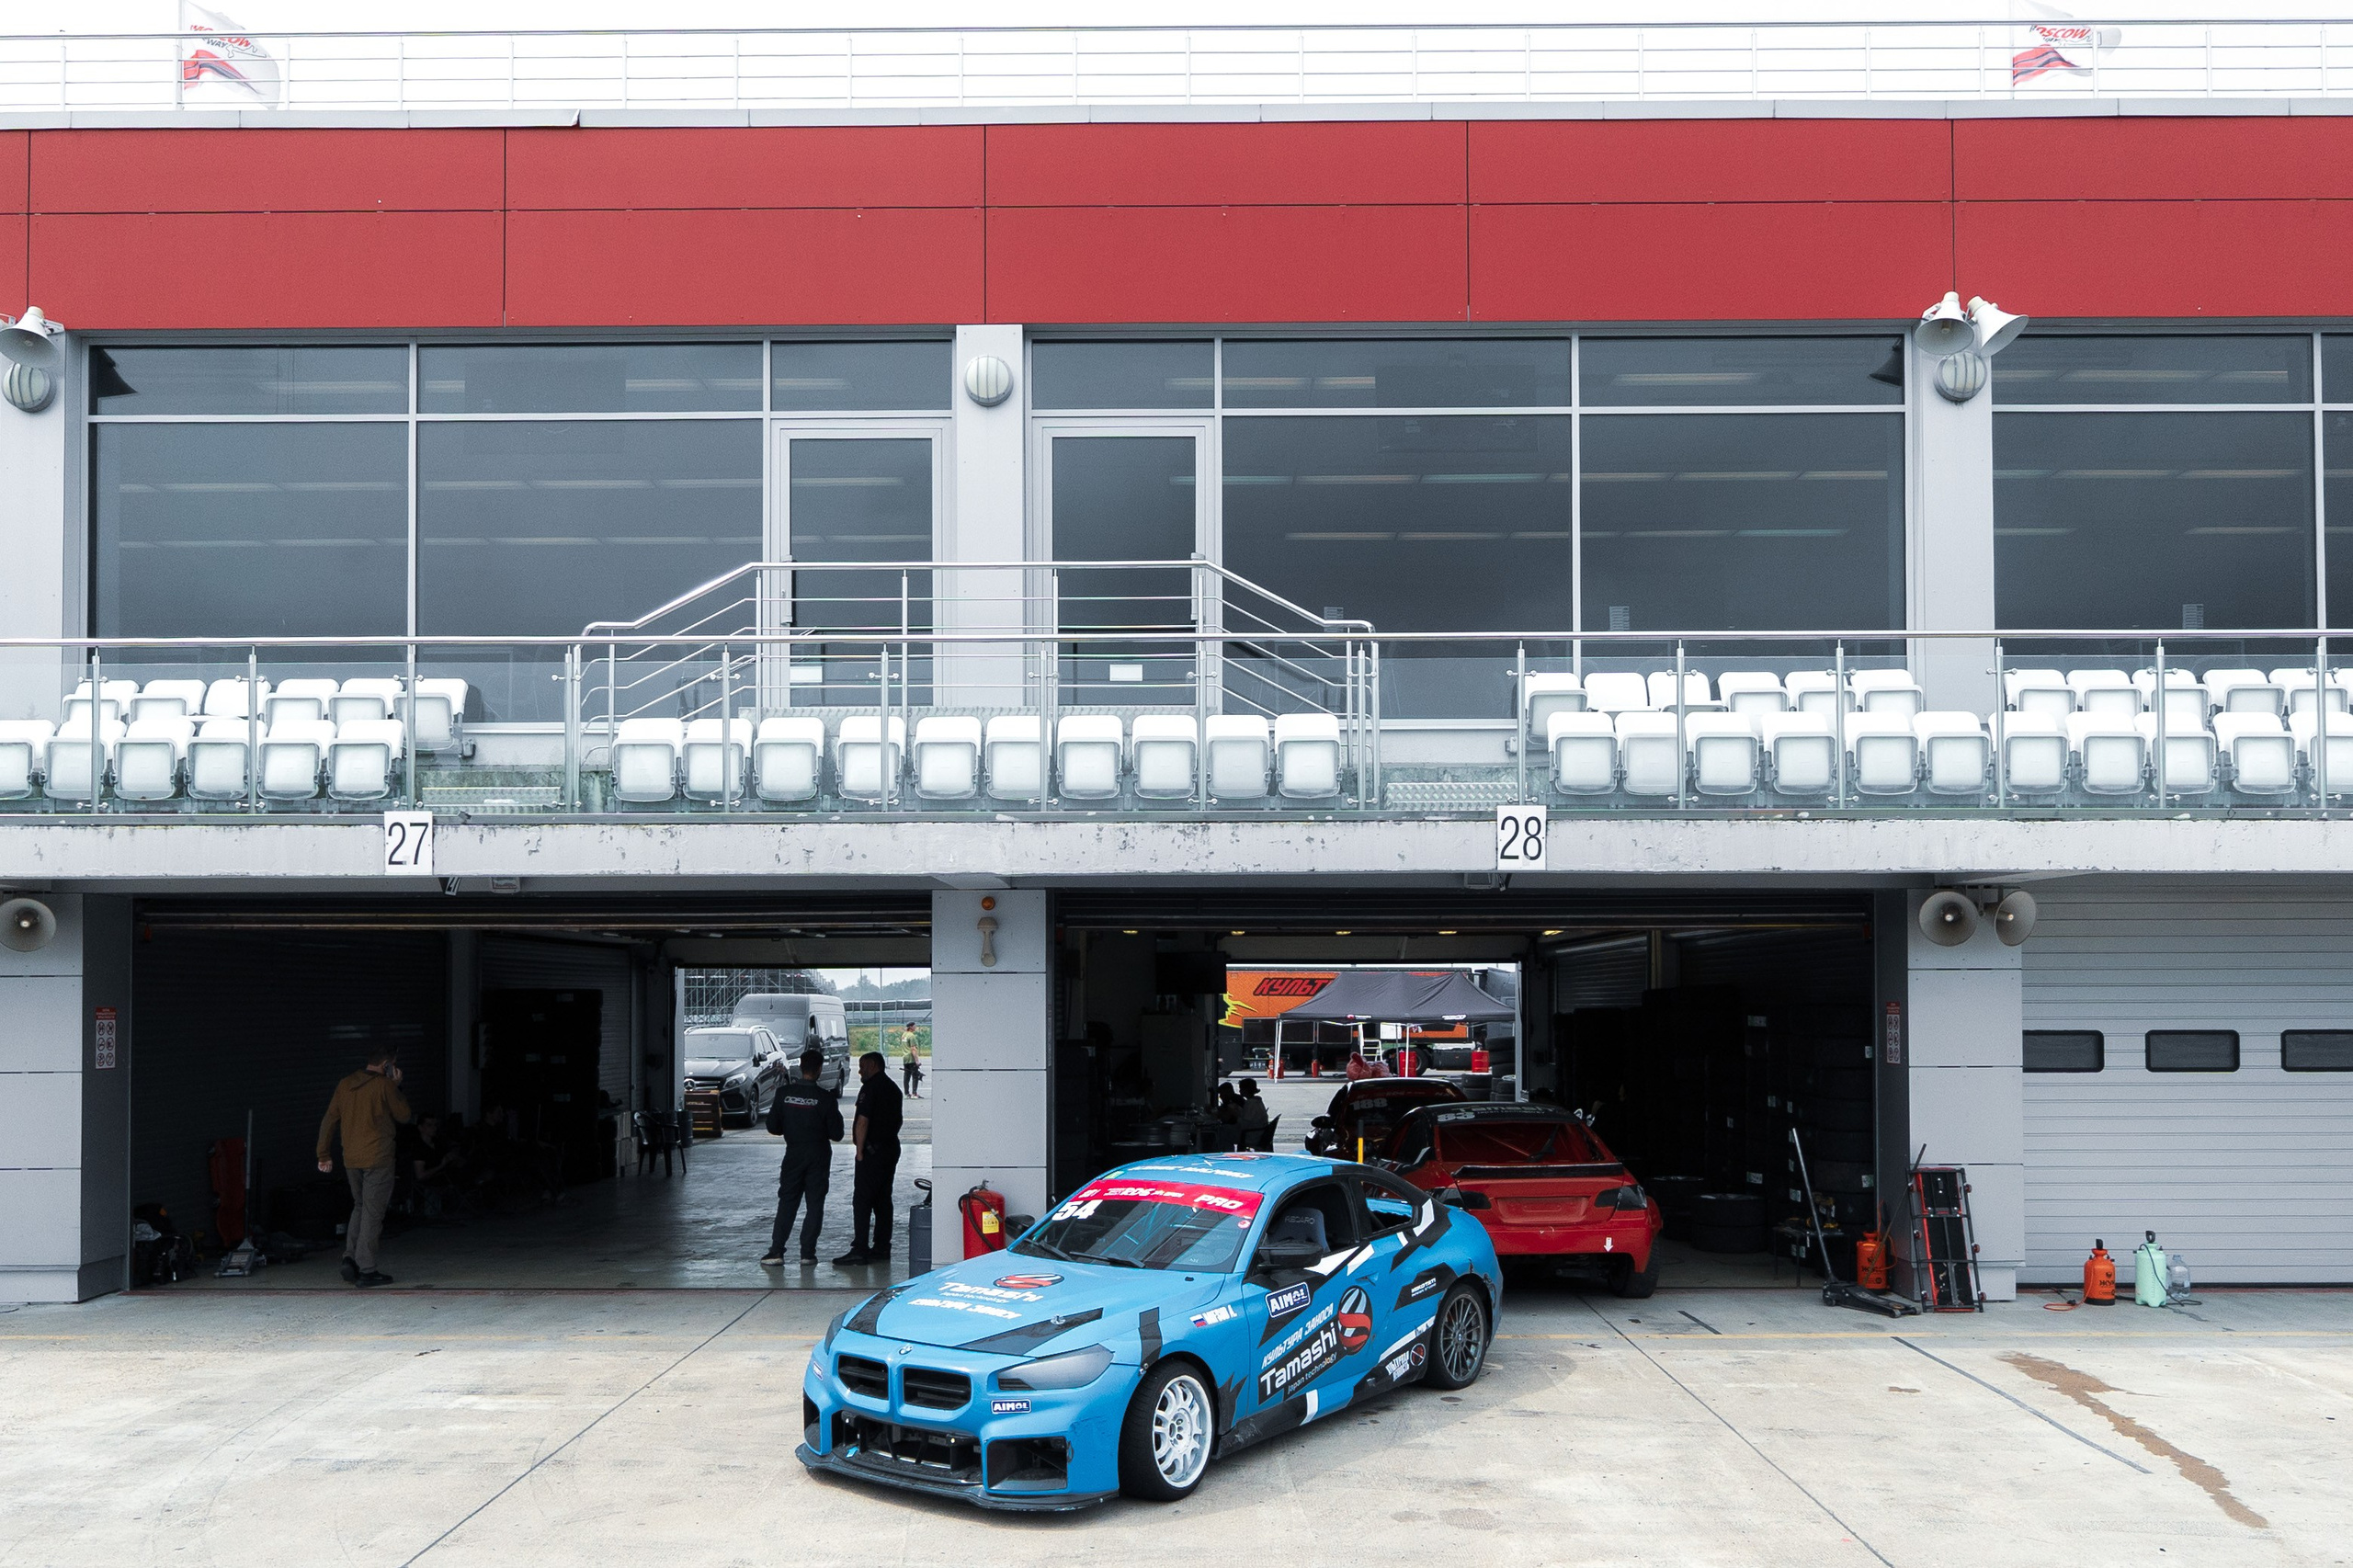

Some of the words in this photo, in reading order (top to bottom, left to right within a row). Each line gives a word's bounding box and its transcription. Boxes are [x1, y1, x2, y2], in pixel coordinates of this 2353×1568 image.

[388, 822, 429, 866] 27
[1500, 815, 1542, 861] 28
[1254, 978, 1334, 995] КУЛЬТ
[1051, 1199, 1103, 1221] 54
[1194, 1195, 1244, 1210] PRO
[1285, 1215, 1315, 1224] RECARO
[938, 1282, 1043, 1302] Tamashi
[1270, 1288, 1308, 1313] AIMOL
[1261, 1327, 1302, 1369] КУЛЬТУРА
[1304, 1302, 1334, 1335] ЗАНОСА
[1260, 1322, 1337, 1396] Tamashi
[1305, 1352, 1337, 1380] technology
[993, 1402, 1029, 1412] AIMOL
